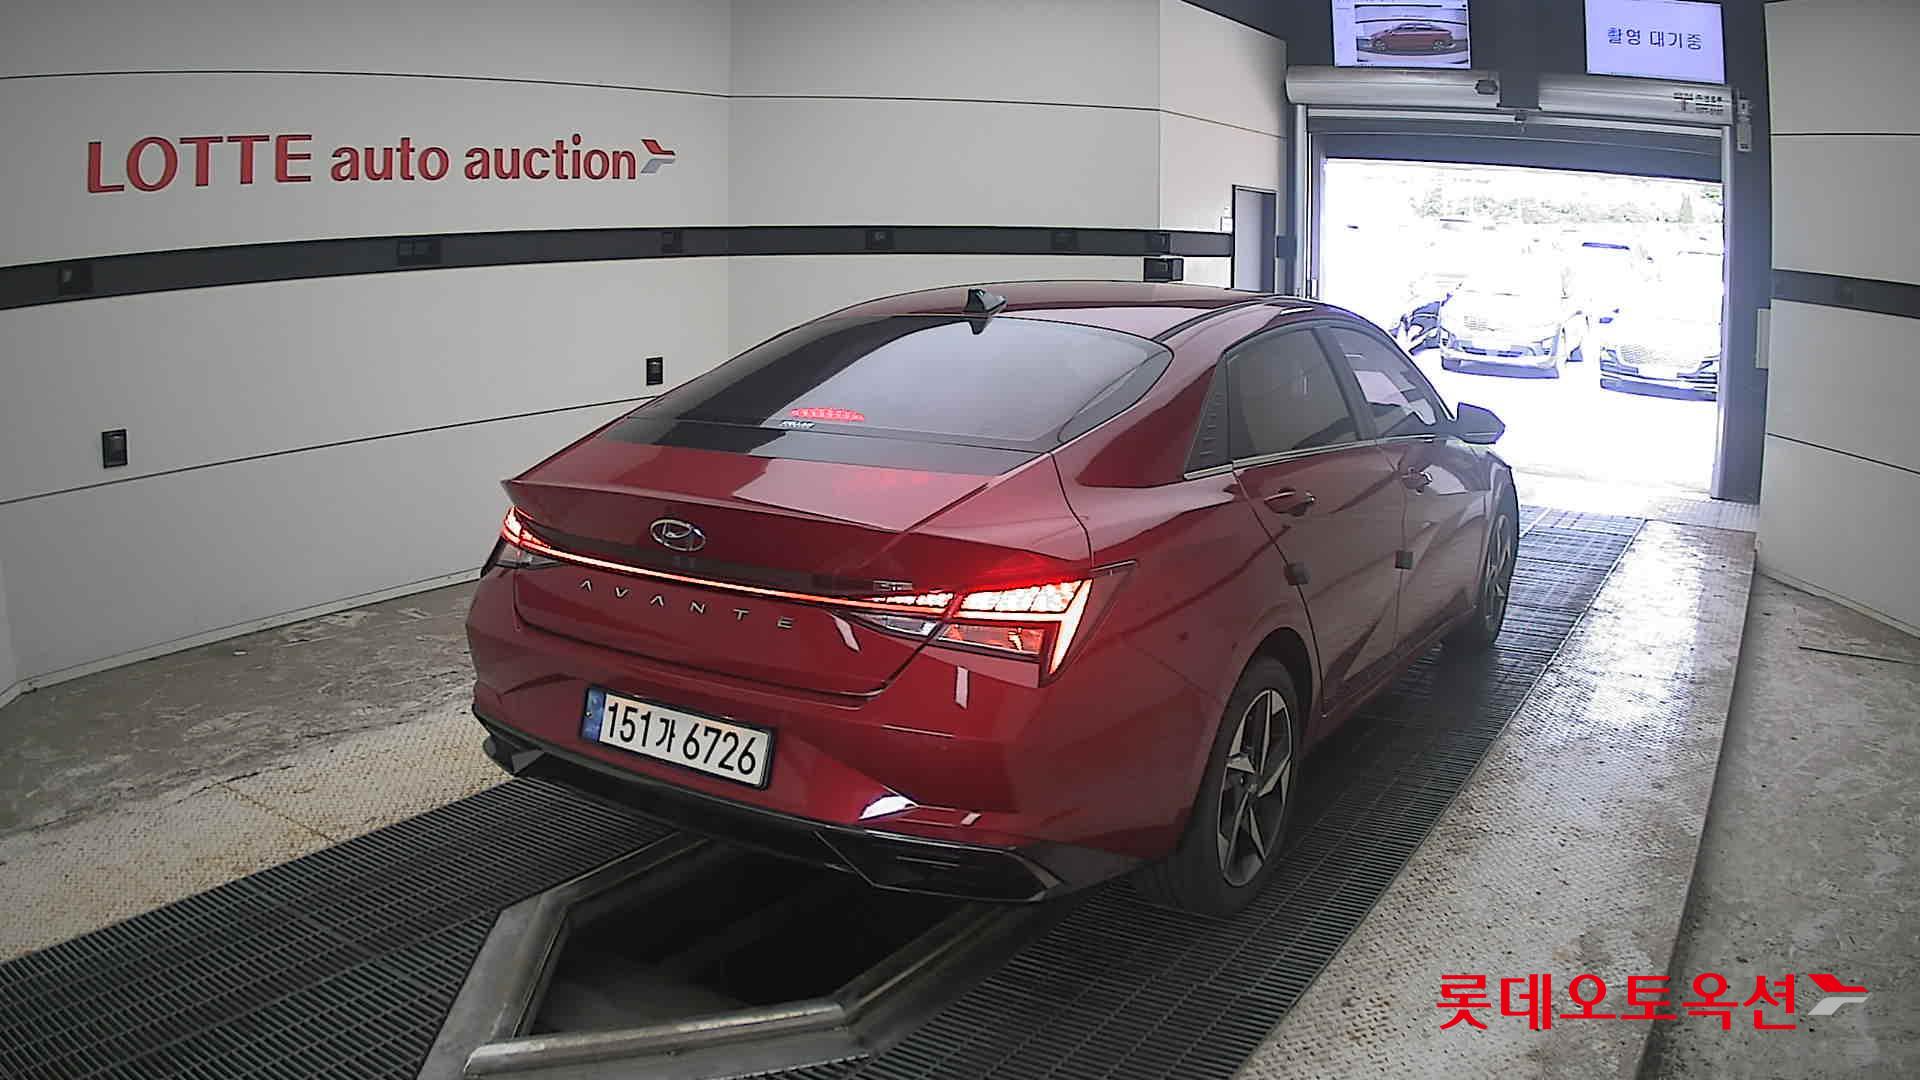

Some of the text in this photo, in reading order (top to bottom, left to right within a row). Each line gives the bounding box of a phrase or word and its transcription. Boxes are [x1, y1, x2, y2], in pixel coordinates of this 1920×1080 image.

[87, 134, 637, 193] LOTTE auto auction
[579, 579, 795, 629] AVANTE
[682, 721, 757, 776] 6726
